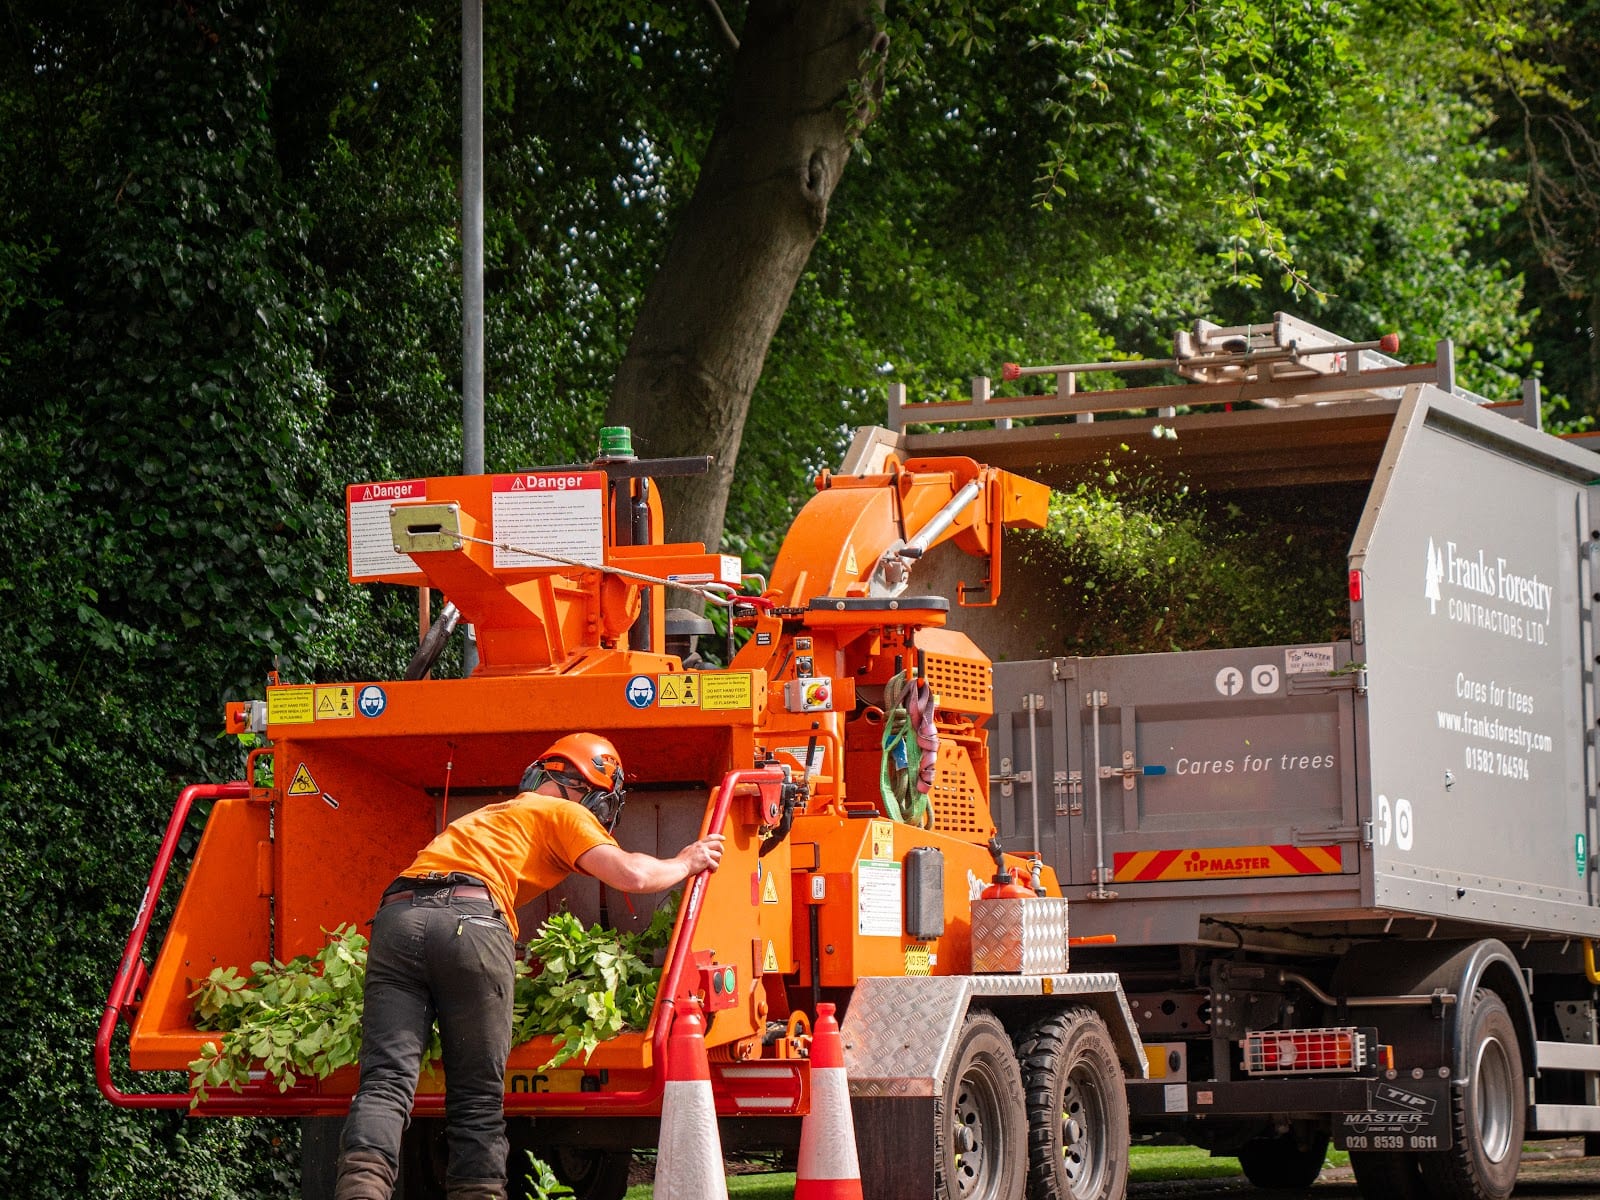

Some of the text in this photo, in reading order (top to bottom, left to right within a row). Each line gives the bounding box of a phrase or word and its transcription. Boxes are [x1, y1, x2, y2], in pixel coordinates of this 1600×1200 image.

[373, 484, 413, 499] Danger
[527, 475, 583, 490] Danger
[1447, 541, 1553, 626] Franks Forestry
[1449, 598, 1549, 646] CONTRACTORS LTD.
[1456, 671, 1534, 715] Cares for trees
[1437, 710, 1553, 753] www.franksforestry.com
[1176, 753, 1335, 776] Cares for trees
[1465, 746, 1530, 781] 01582 764594
[1387, 1088, 1427, 1105] TIP
[1345, 1114, 1423, 1122] MASTER
[1346, 1135, 1438, 1149] 020 8539 0611
